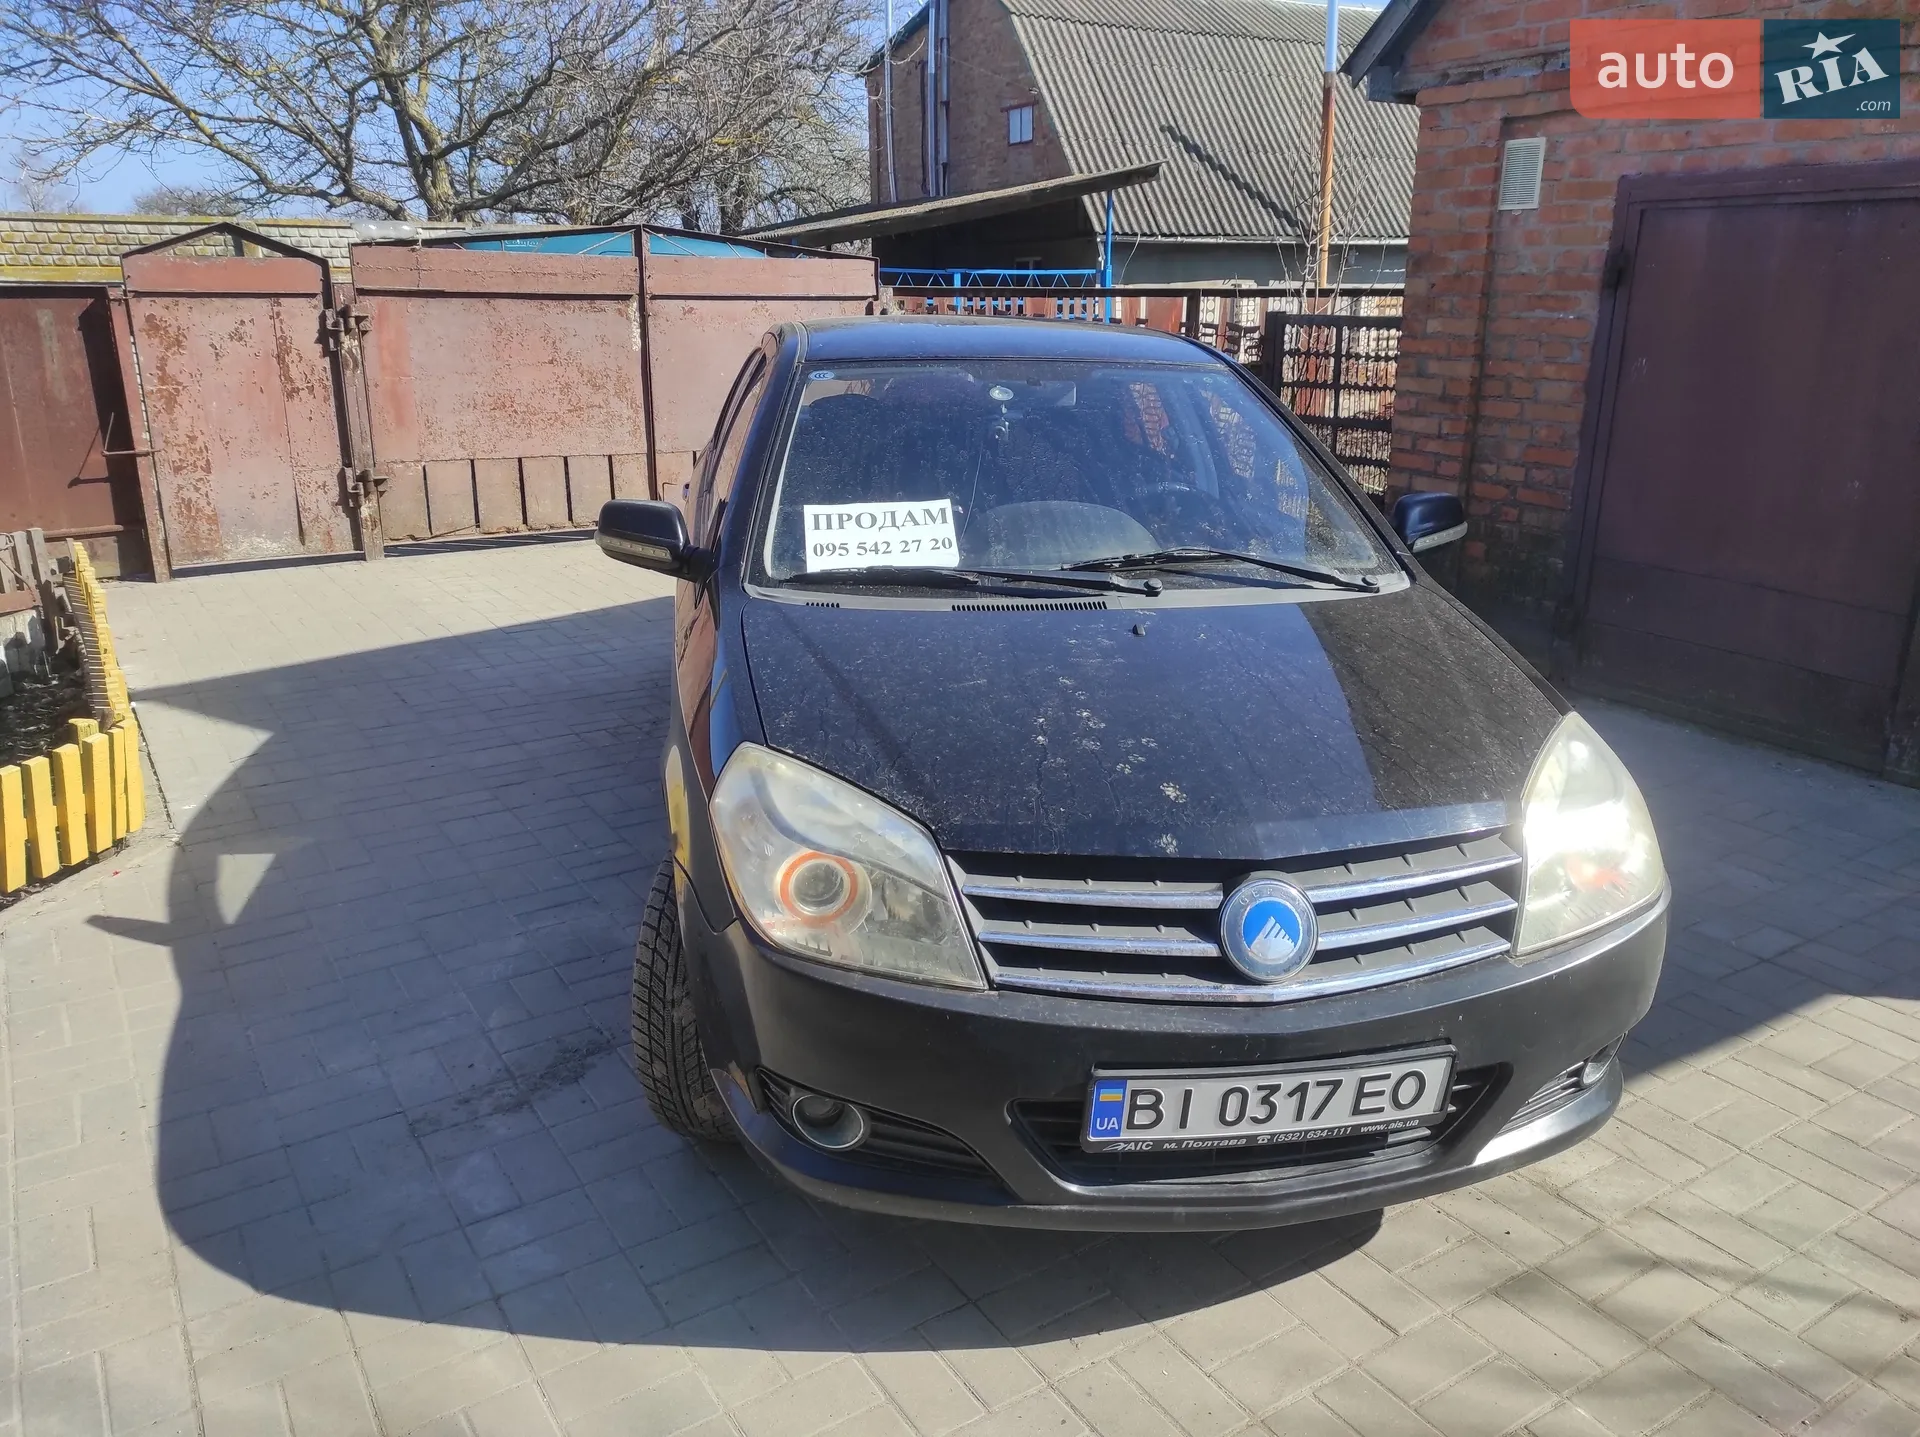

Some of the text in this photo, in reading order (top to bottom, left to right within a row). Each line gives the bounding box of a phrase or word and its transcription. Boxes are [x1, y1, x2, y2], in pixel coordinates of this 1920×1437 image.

[812, 507, 949, 531] ПРОДАМ
[813, 537, 953, 557] 095 542 27 20
[1126, 1069, 1427, 1130] BI 0317 EO
[1096, 1117, 1119, 1130] UA
[1181, 1137, 1247, 1149] Полтава
[1273, 1131, 1304, 1142] (532)
[1307, 1126, 1352, 1139] 634-111
[1360, 1119, 1420, 1132] www.ais.ua
